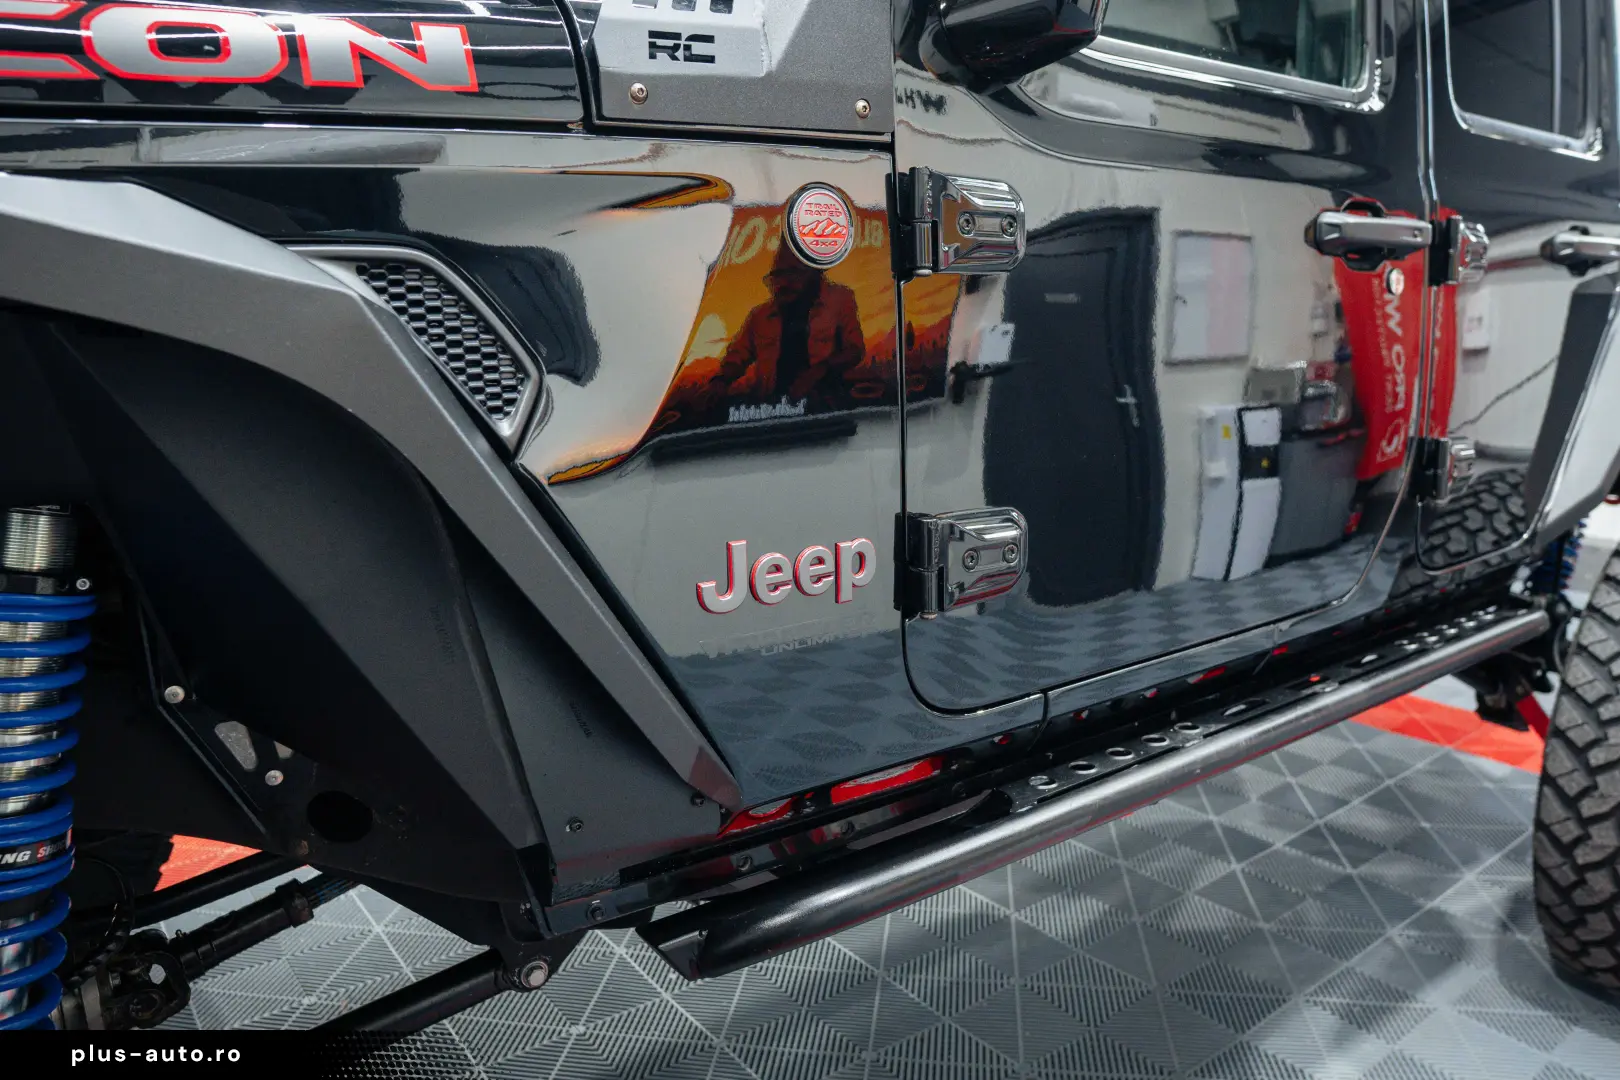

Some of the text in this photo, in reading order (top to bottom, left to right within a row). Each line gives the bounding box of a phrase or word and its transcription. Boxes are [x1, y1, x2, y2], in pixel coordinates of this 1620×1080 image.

[648, 30, 716, 64] RC
[804, 209, 842, 218] RATED
[805, 202, 840, 211] TRAIL
[696, 537, 876, 614] Jeep
